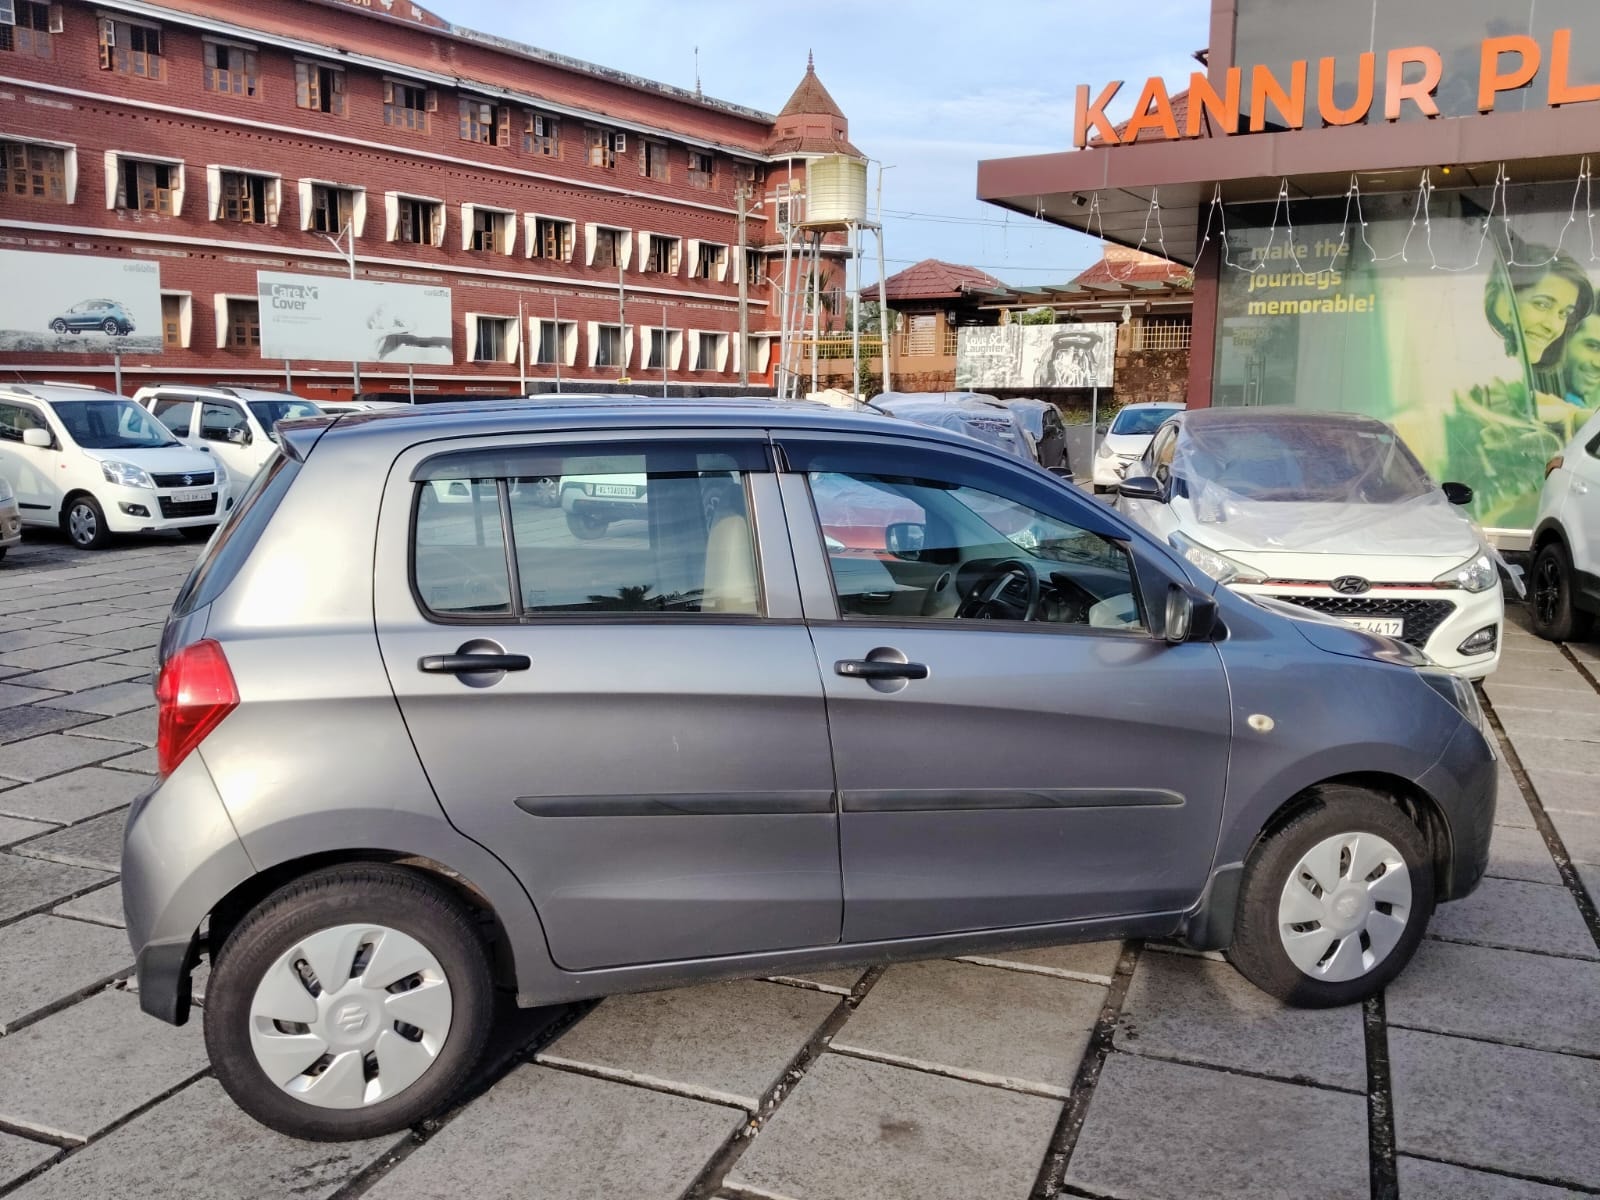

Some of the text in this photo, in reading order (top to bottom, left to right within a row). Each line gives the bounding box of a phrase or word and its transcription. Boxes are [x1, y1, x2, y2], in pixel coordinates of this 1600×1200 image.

[1073, 28, 1600, 148] KANNUR PL
[1251, 238, 1349, 260] make the
[1248, 271, 1342, 292] journeys
[271, 284, 300, 298] Care
[272, 296, 307, 310] Cover
[1248, 294, 1376, 315] memorable!
[965, 335, 987, 345] Love
[966, 343, 1004, 354] Laughter
[1368, 622, 1400, 634] 4417
